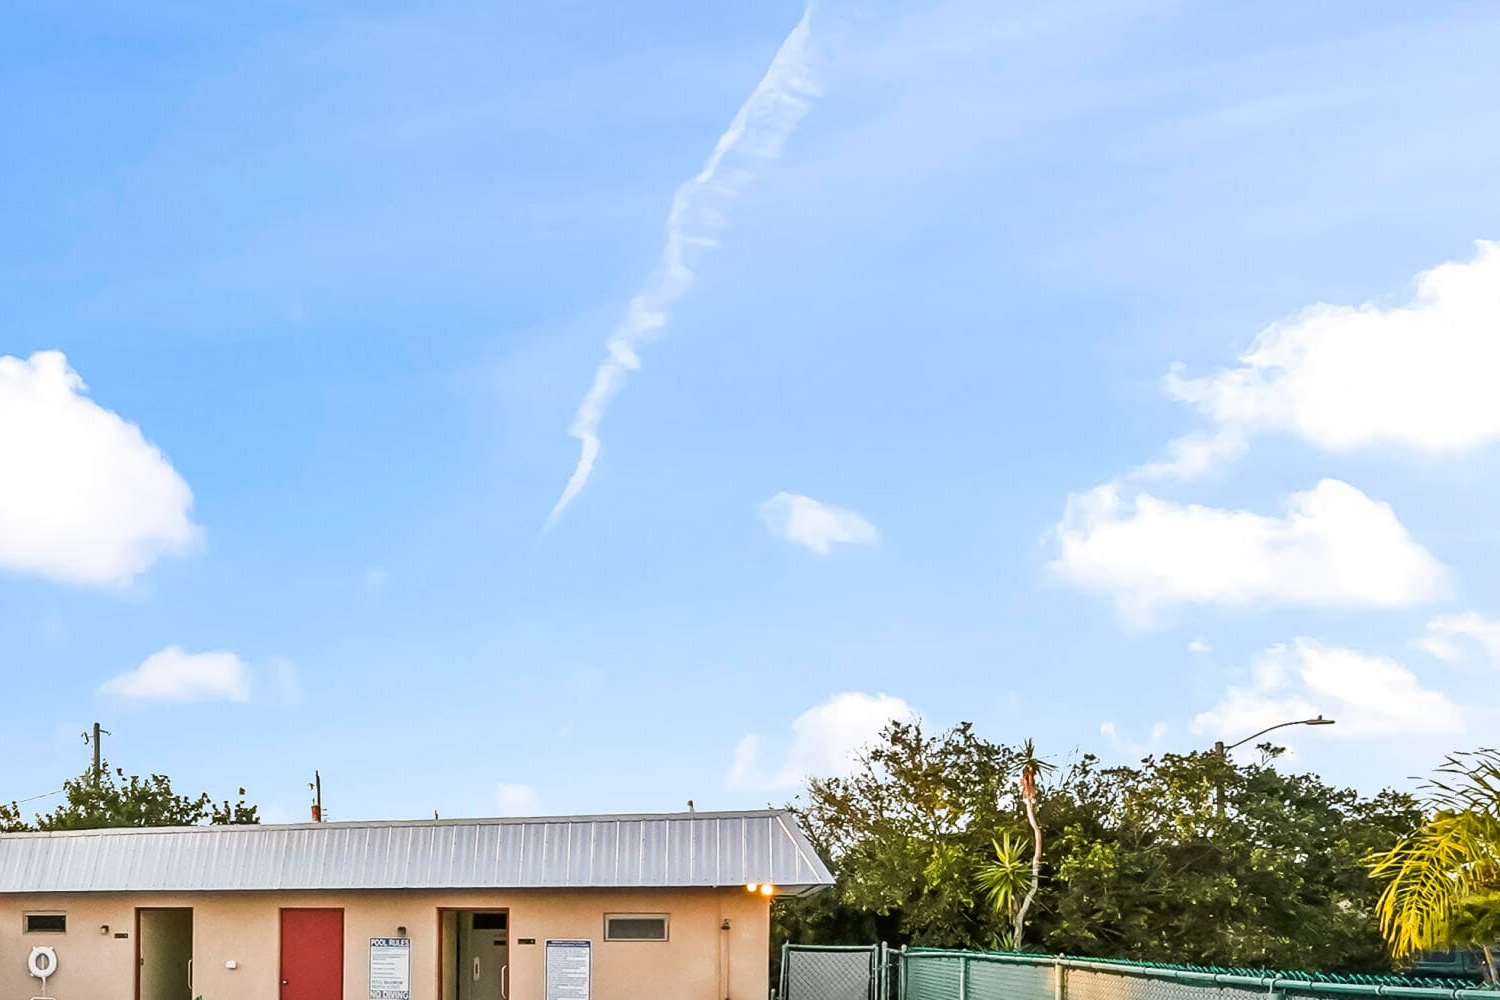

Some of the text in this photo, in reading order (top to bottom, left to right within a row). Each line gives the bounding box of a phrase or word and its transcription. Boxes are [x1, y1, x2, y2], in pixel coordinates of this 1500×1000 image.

[371, 939, 409, 947] POOL RULES
[372, 990, 409, 1000] NO DIVING
